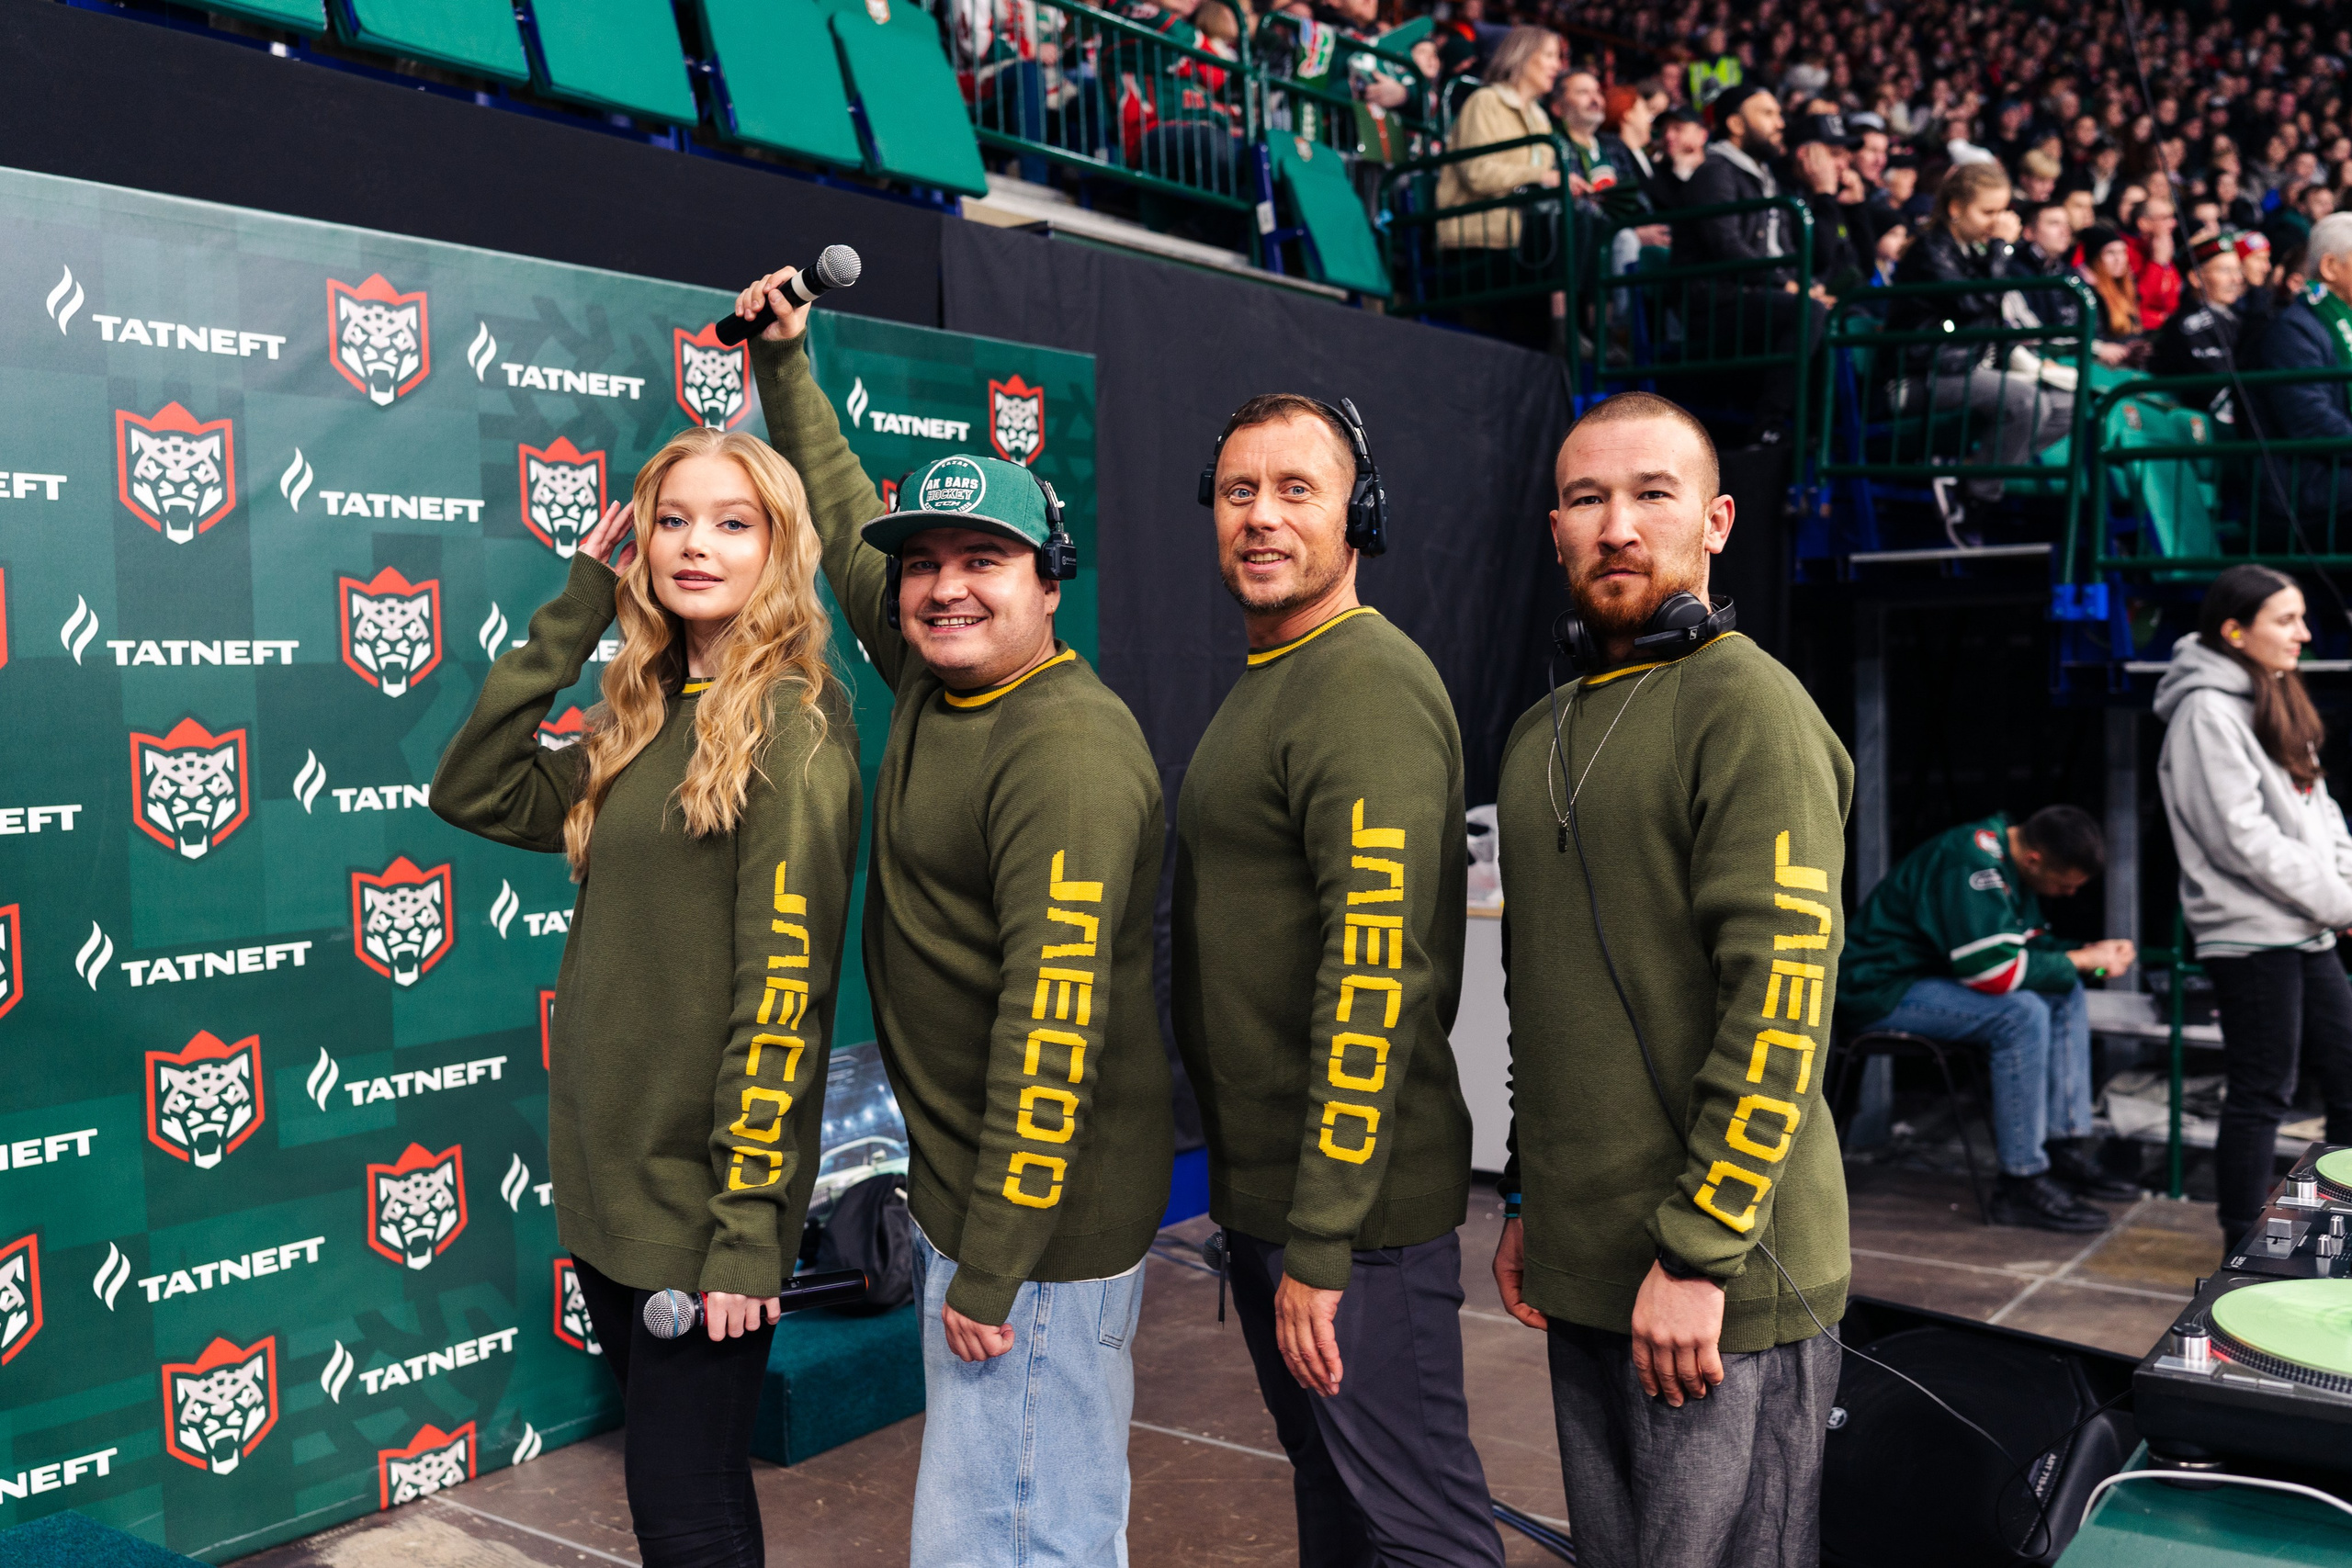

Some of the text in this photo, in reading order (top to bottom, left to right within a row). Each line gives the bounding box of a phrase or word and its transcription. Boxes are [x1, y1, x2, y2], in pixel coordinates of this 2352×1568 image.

[91, 313, 287, 361] TATNEFT
[500, 362, 646, 400] TATNEFT
[869, 411, 970, 442] TATNEFT
[318, 490, 485, 523] TATNEFT
[925, 476, 979, 491] AK BARS
[926, 488, 974, 502] HOCKEY
[1063, 533, 1069, 544] 3
[106, 639, 300, 666] TATNEFT
[120, 941, 312, 987] TATNEFT
[1318, 797, 1407, 1165] JAECOO
[728, 860, 810, 1191] JAECOO
[1001, 849, 1104, 1209] JAECOO
[1693, 829, 1833, 1234] JAECOO
[345, 1055, 507, 1106] TATNEFT
[138, 1235, 325, 1303] TATNEFT
[358, 1327, 518, 1395] TATNEFT
